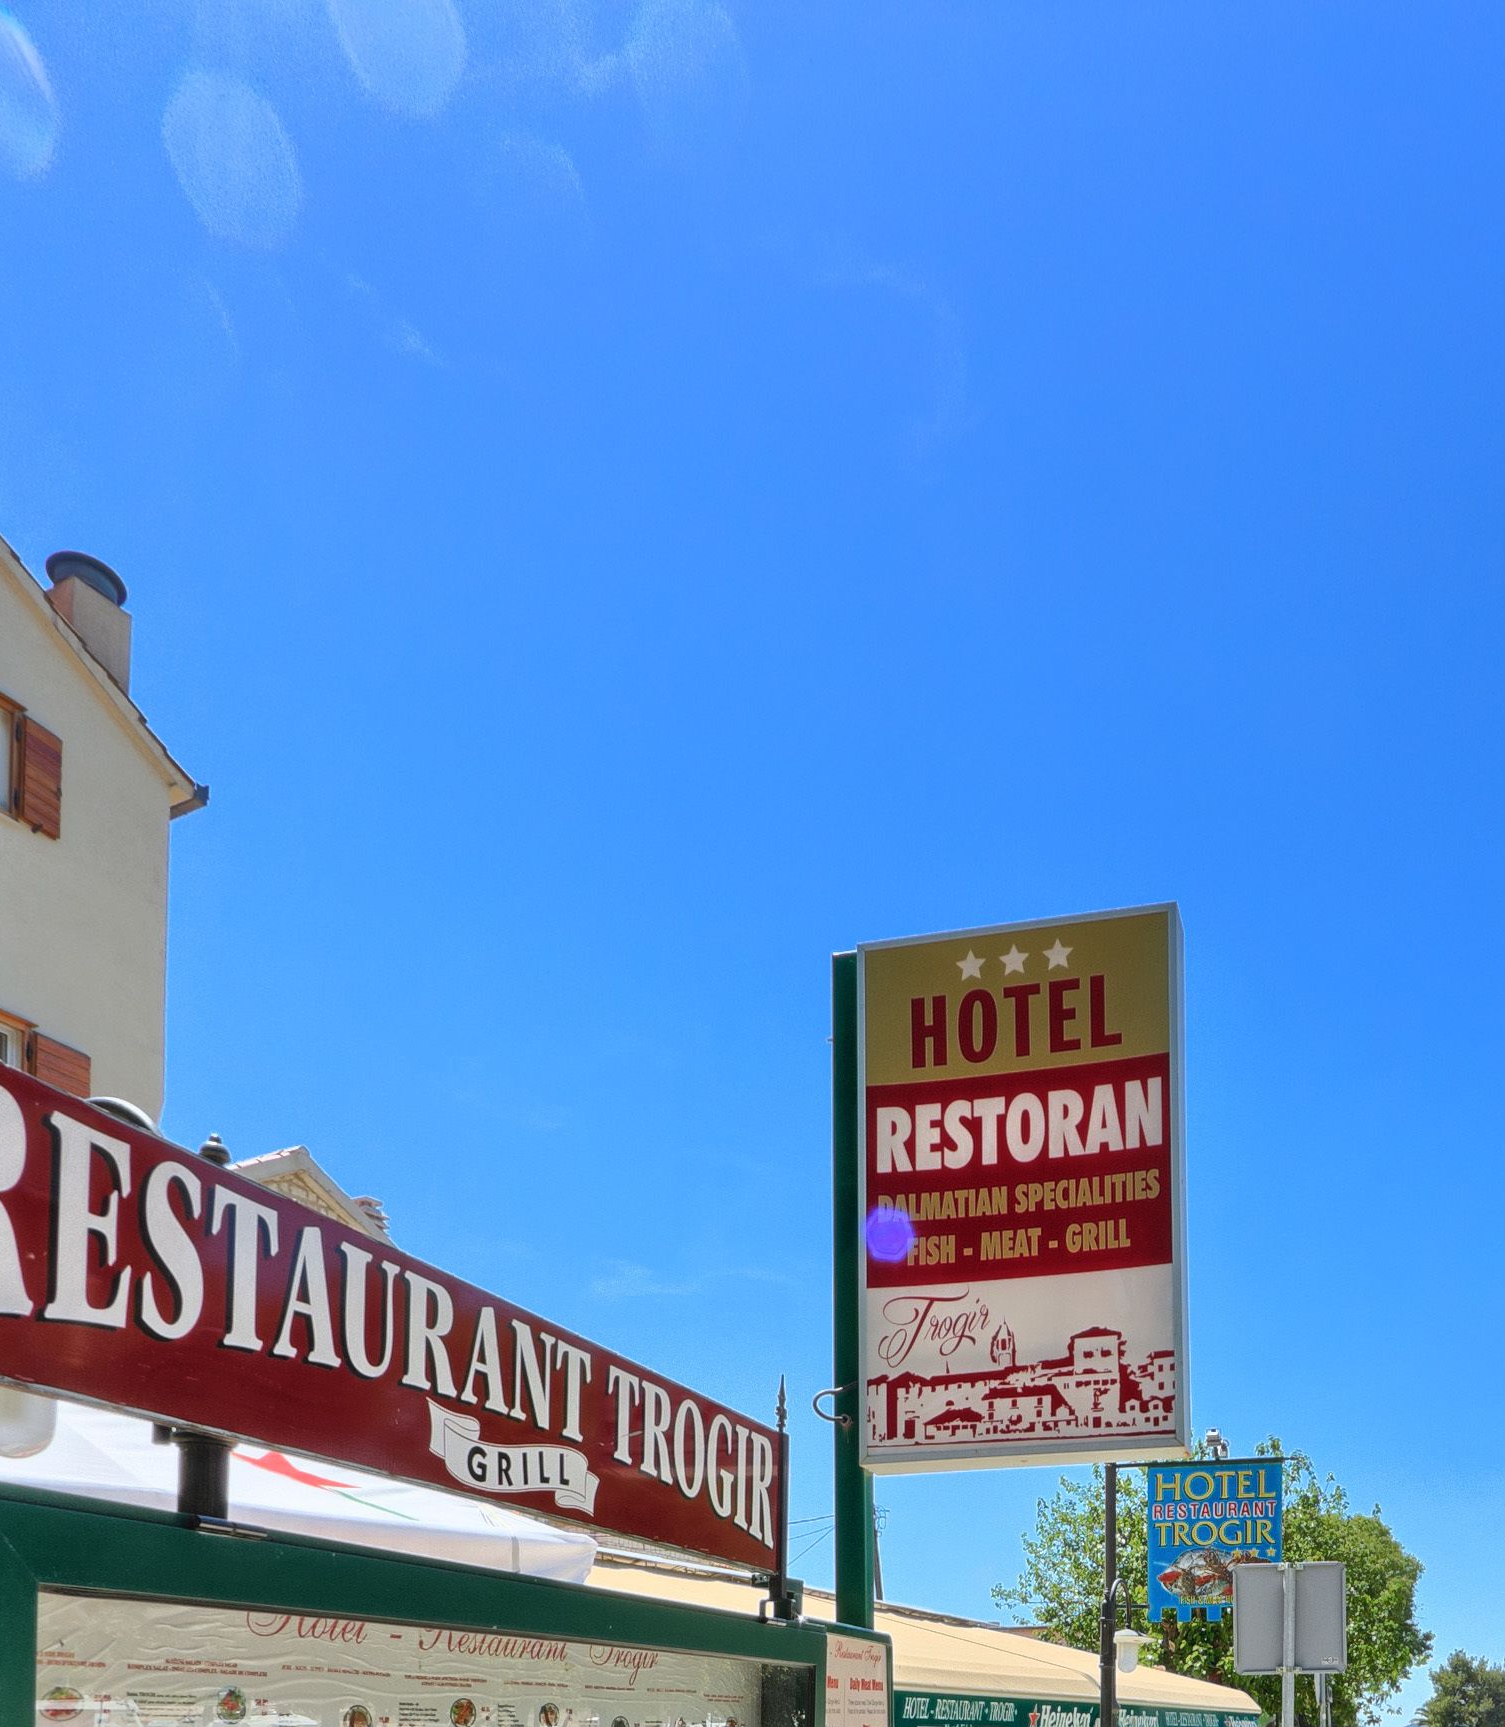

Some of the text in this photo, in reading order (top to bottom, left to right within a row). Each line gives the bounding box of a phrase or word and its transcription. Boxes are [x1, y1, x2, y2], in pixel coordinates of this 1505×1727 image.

[910, 974, 1123, 1069] HOTEL
[876, 1076, 1163, 1173] RESTORAN
[878, 1168, 1161, 1223] DALMATIAN SPECIALITIES
[907, 1235, 956, 1266] FISH
[980, 1228, 1042, 1261] MEAT
[1065, 1219, 1132, 1253] GRILL
[877, 1285, 991, 1368] Trogir
[467, 1445, 570, 1487] GRILL
[606, 1364, 775, 1550] TROGIR
[1155, 1470, 1277, 1502] HOTEL
[1152, 1500, 1277, 1520] RESTAURANT
[1154, 1519, 1276, 1548] TROGIR
[902, 1697, 930, 1719] HOTEL
[934, 1699, 984, 1721] RESTAURANT
[989, 1701, 1015, 1722] TROGIR
